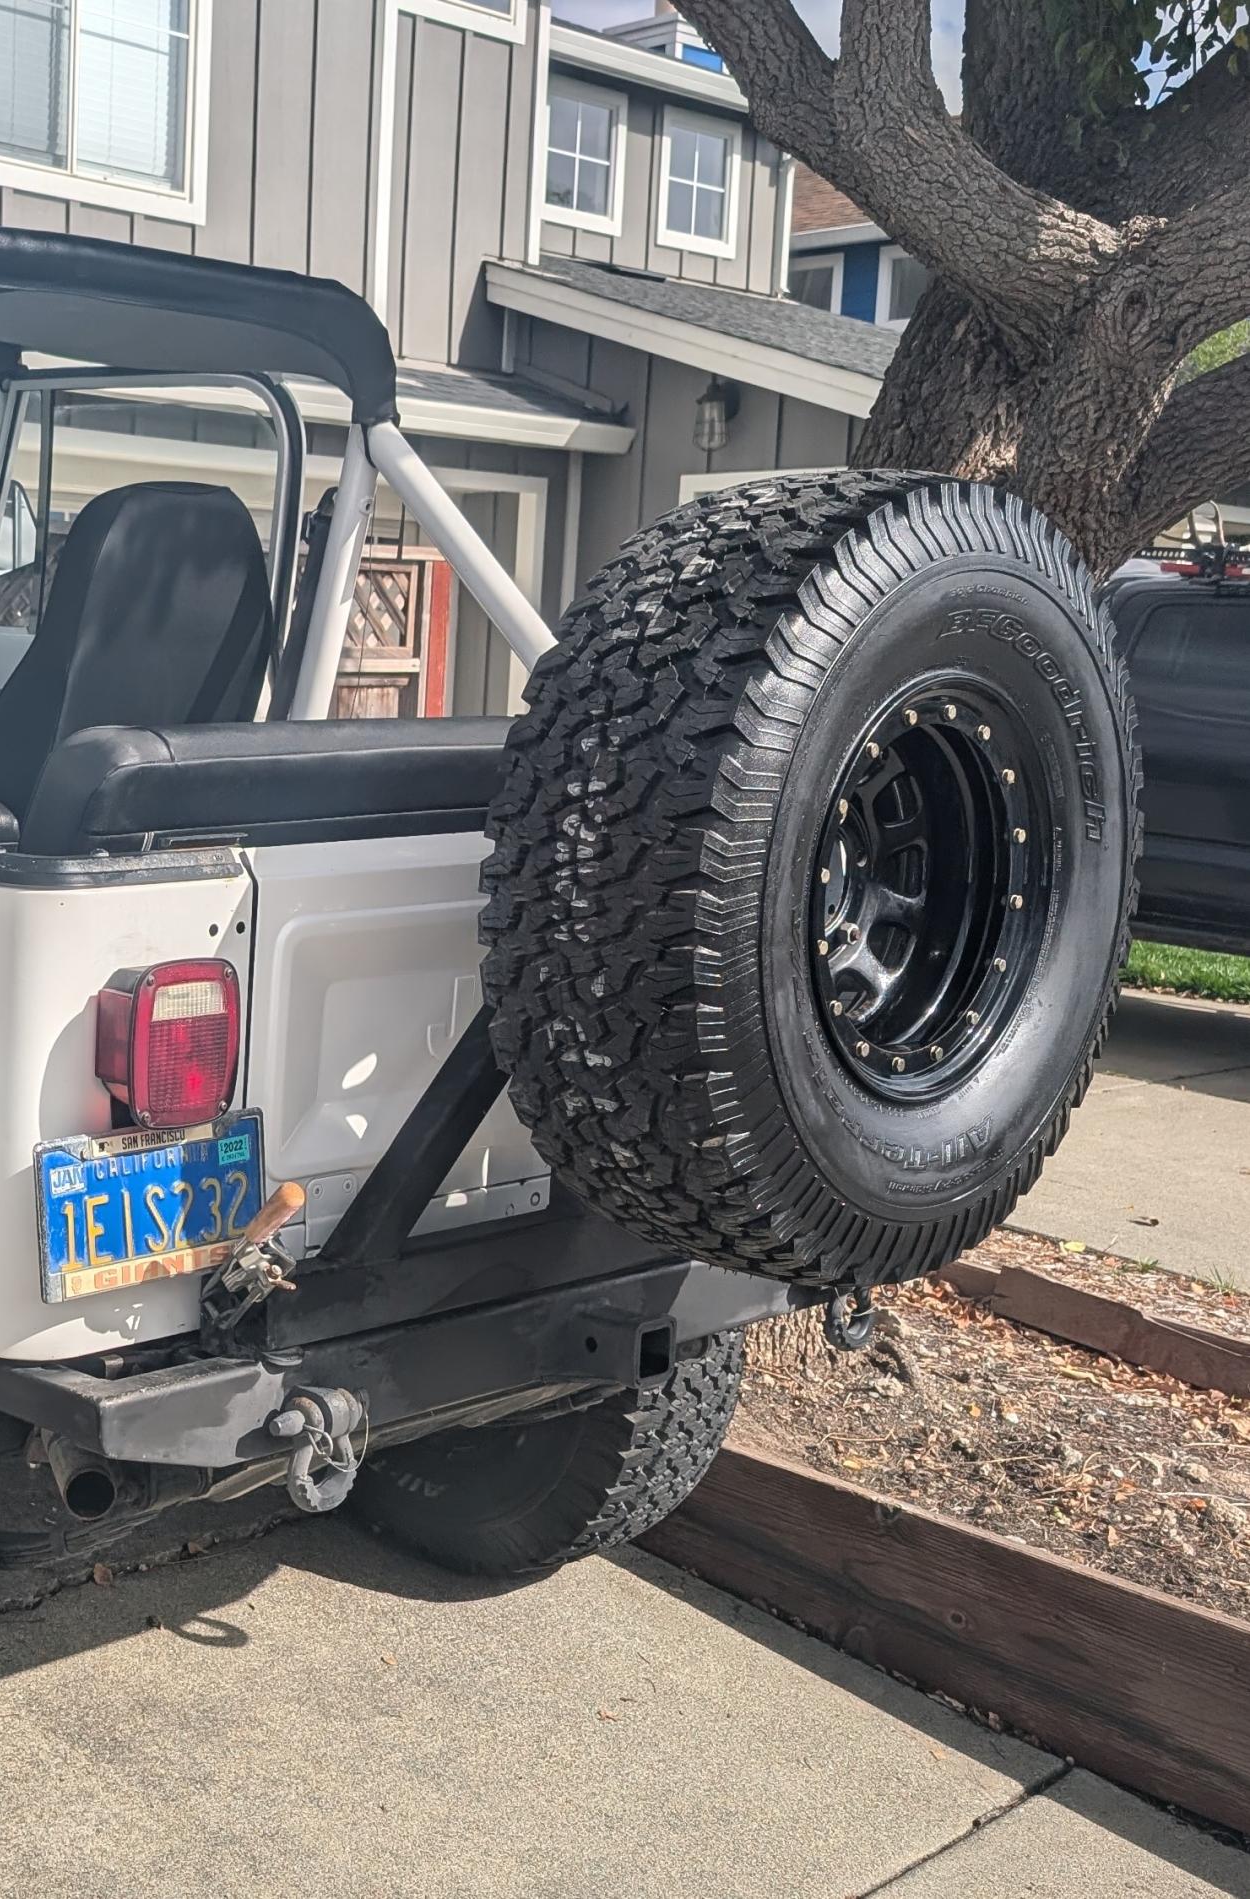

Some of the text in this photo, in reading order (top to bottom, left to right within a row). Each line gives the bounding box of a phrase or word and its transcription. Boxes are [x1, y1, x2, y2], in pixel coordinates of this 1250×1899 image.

[121, 1129, 185, 1150] SAN FRANCISCO
[223, 1139, 244, 1154] 2022
[94, 1143, 210, 1181] CALIFORNIA
[52, 1164, 83, 1188] JAN
[93, 1245, 232, 1291] GIANTS
